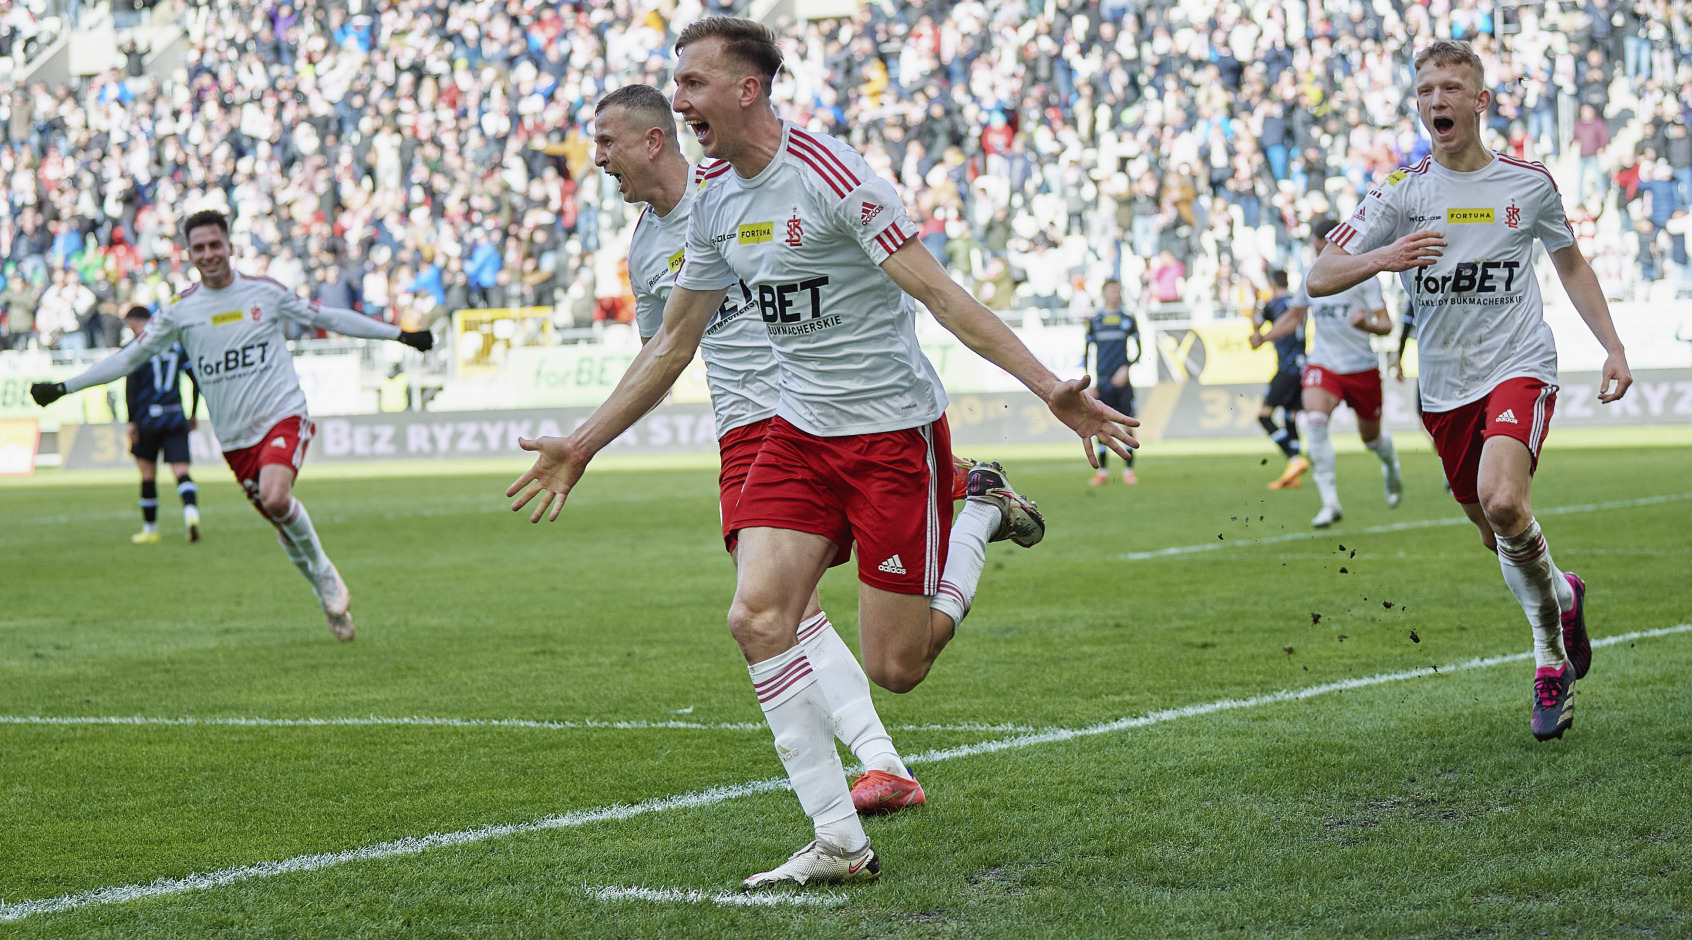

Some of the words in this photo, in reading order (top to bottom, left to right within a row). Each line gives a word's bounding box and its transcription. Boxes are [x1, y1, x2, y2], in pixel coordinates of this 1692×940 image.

[862, 204, 884, 226] adidas
[741, 229, 771, 239] FORTUNA
[1415, 261, 1520, 295] forBET
[767, 315, 842, 336] BUKMACHERSKIE
[199, 341, 269, 378] forBET
[150, 352, 178, 392] 17
[1495, 417, 1518, 425] adidas
[878, 564, 907, 575] adidas
